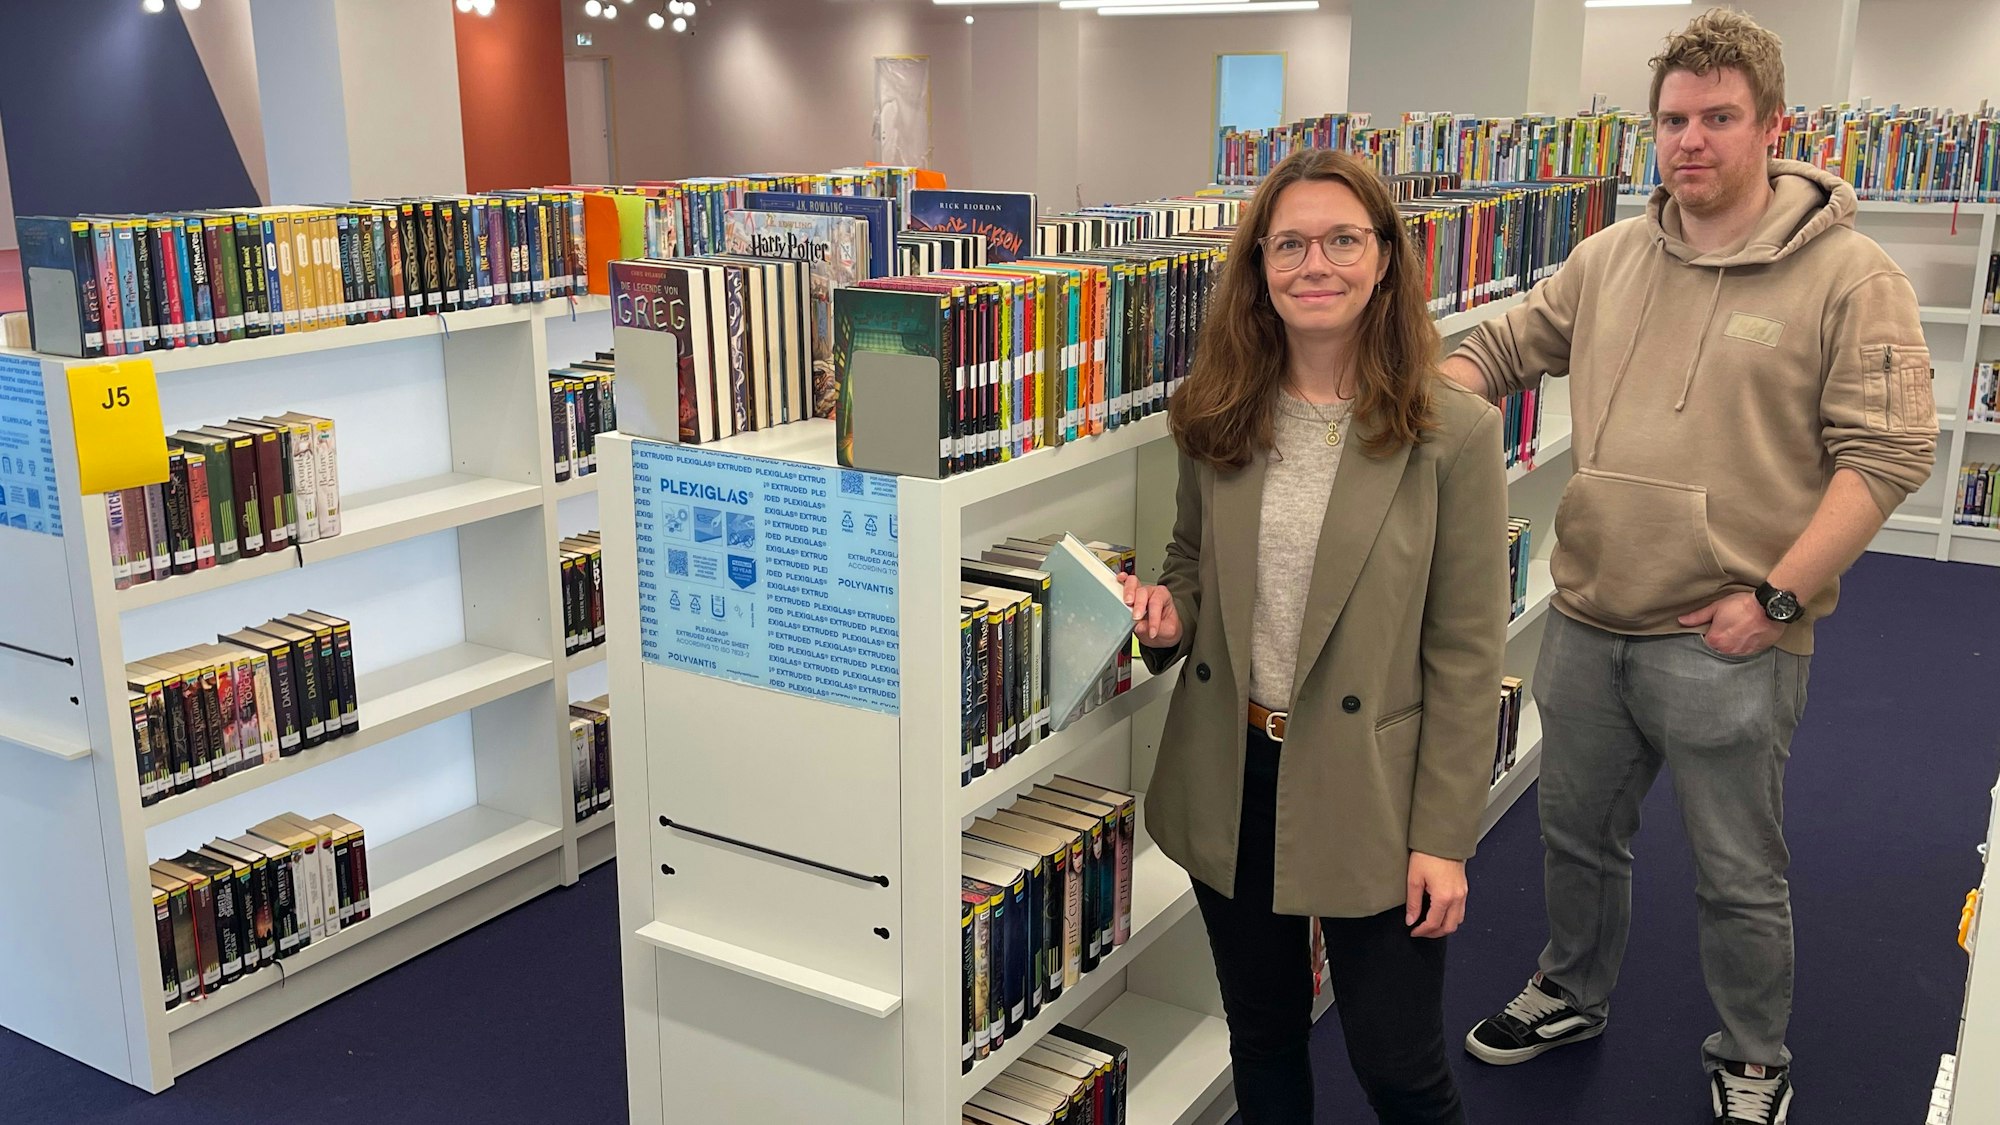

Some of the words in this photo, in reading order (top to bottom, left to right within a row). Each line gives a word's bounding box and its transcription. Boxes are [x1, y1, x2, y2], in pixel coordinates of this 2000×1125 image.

[810, 200, 843, 213] ROWLING
[406, 220, 419, 291] EVOLUTION
[426, 218, 439, 288] EVOLUTION
[462, 220, 471, 272] COUNTDOWN
[749, 234, 786, 257] Harry
[787, 232, 828, 264] Potter
[621, 281, 631, 291] DIE
[633, 282, 662, 294] LEGENDE
[664, 286, 679, 296] VON
[617, 293, 686, 330] GREG
[102, 386, 130, 410] J5
[318, 455, 328, 487] Before
[327, 451, 336, 487] Destiny
[641, 451, 673, 462] EXTRUDED
[677, 456, 716, 468] PLEXIGLAS®
[717, 463, 752, 473] EXTRUDED
[755, 468, 797, 480] PLEXIGLAS®
[771, 484, 807, 495] EXTRUDED
[784, 498, 826, 509] PLEXIGLAS®
[772, 521, 808, 532] EXTRUDED
[785, 536, 826, 547] PLEXIGLAS®
[774, 558, 809, 570] EXTRUDED
[848, 553, 881, 564] EXTRUDED
[848, 562, 888, 574] ACCORDING
[786, 573, 827, 585] PLEXIGLAS®
[838, 578, 894, 595] POLYVANTIS
[775, 595, 810, 607] EXTRUDED
[814, 602, 856, 615] PLEXIGLAS®
[858, 611, 895, 624] EXTRUDED
[787, 610, 828, 622] PLEXIGLAS®
[830, 618, 866, 630] EXTRUDED
[676, 630, 705, 640] EXTRUDED
[706, 635, 730, 646] ACRYLIC
[776, 632, 811, 645] EXTRUDED
[815, 640, 856, 652] PLEXIGLAS®
[858, 648, 895, 661] EXTRUDED
[803, 625, 838, 637] EXTRUDED
[842, 633, 885, 646] PLEXIGLAS®
[668, 652, 717, 669] POLYVANTIS
[788, 647, 828, 660] PLEXIGLAS®
[831, 655, 867, 668] EXTRUDED
[306, 668, 316, 699] DARK
[777, 668, 812, 681] EXTRUDED
[816, 677, 857, 690] PLEXIGLAS®
[859, 686, 896, 699] EXTRUDED
[804, 662, 839, 674] EXTRUDED
[843, 670, 885, 684] PLEXIGLAS®
[225, 686, 233, 706] KISS
[243, 672, 253, 705] TOUCH
[280, 679, 292, 708] DARK
[190, 695, 204, 732] KINGDOM
[208, 690, 219, 727] KINGDOM
[1120, 839, 1129, 872] LOST
[1067, 874, 1078, 915] CURSE
[1119, 876, 1129, 902] THE
[217, 894, 225, 917] SHIELD
[1068, 921, 1078, 944] HIS
